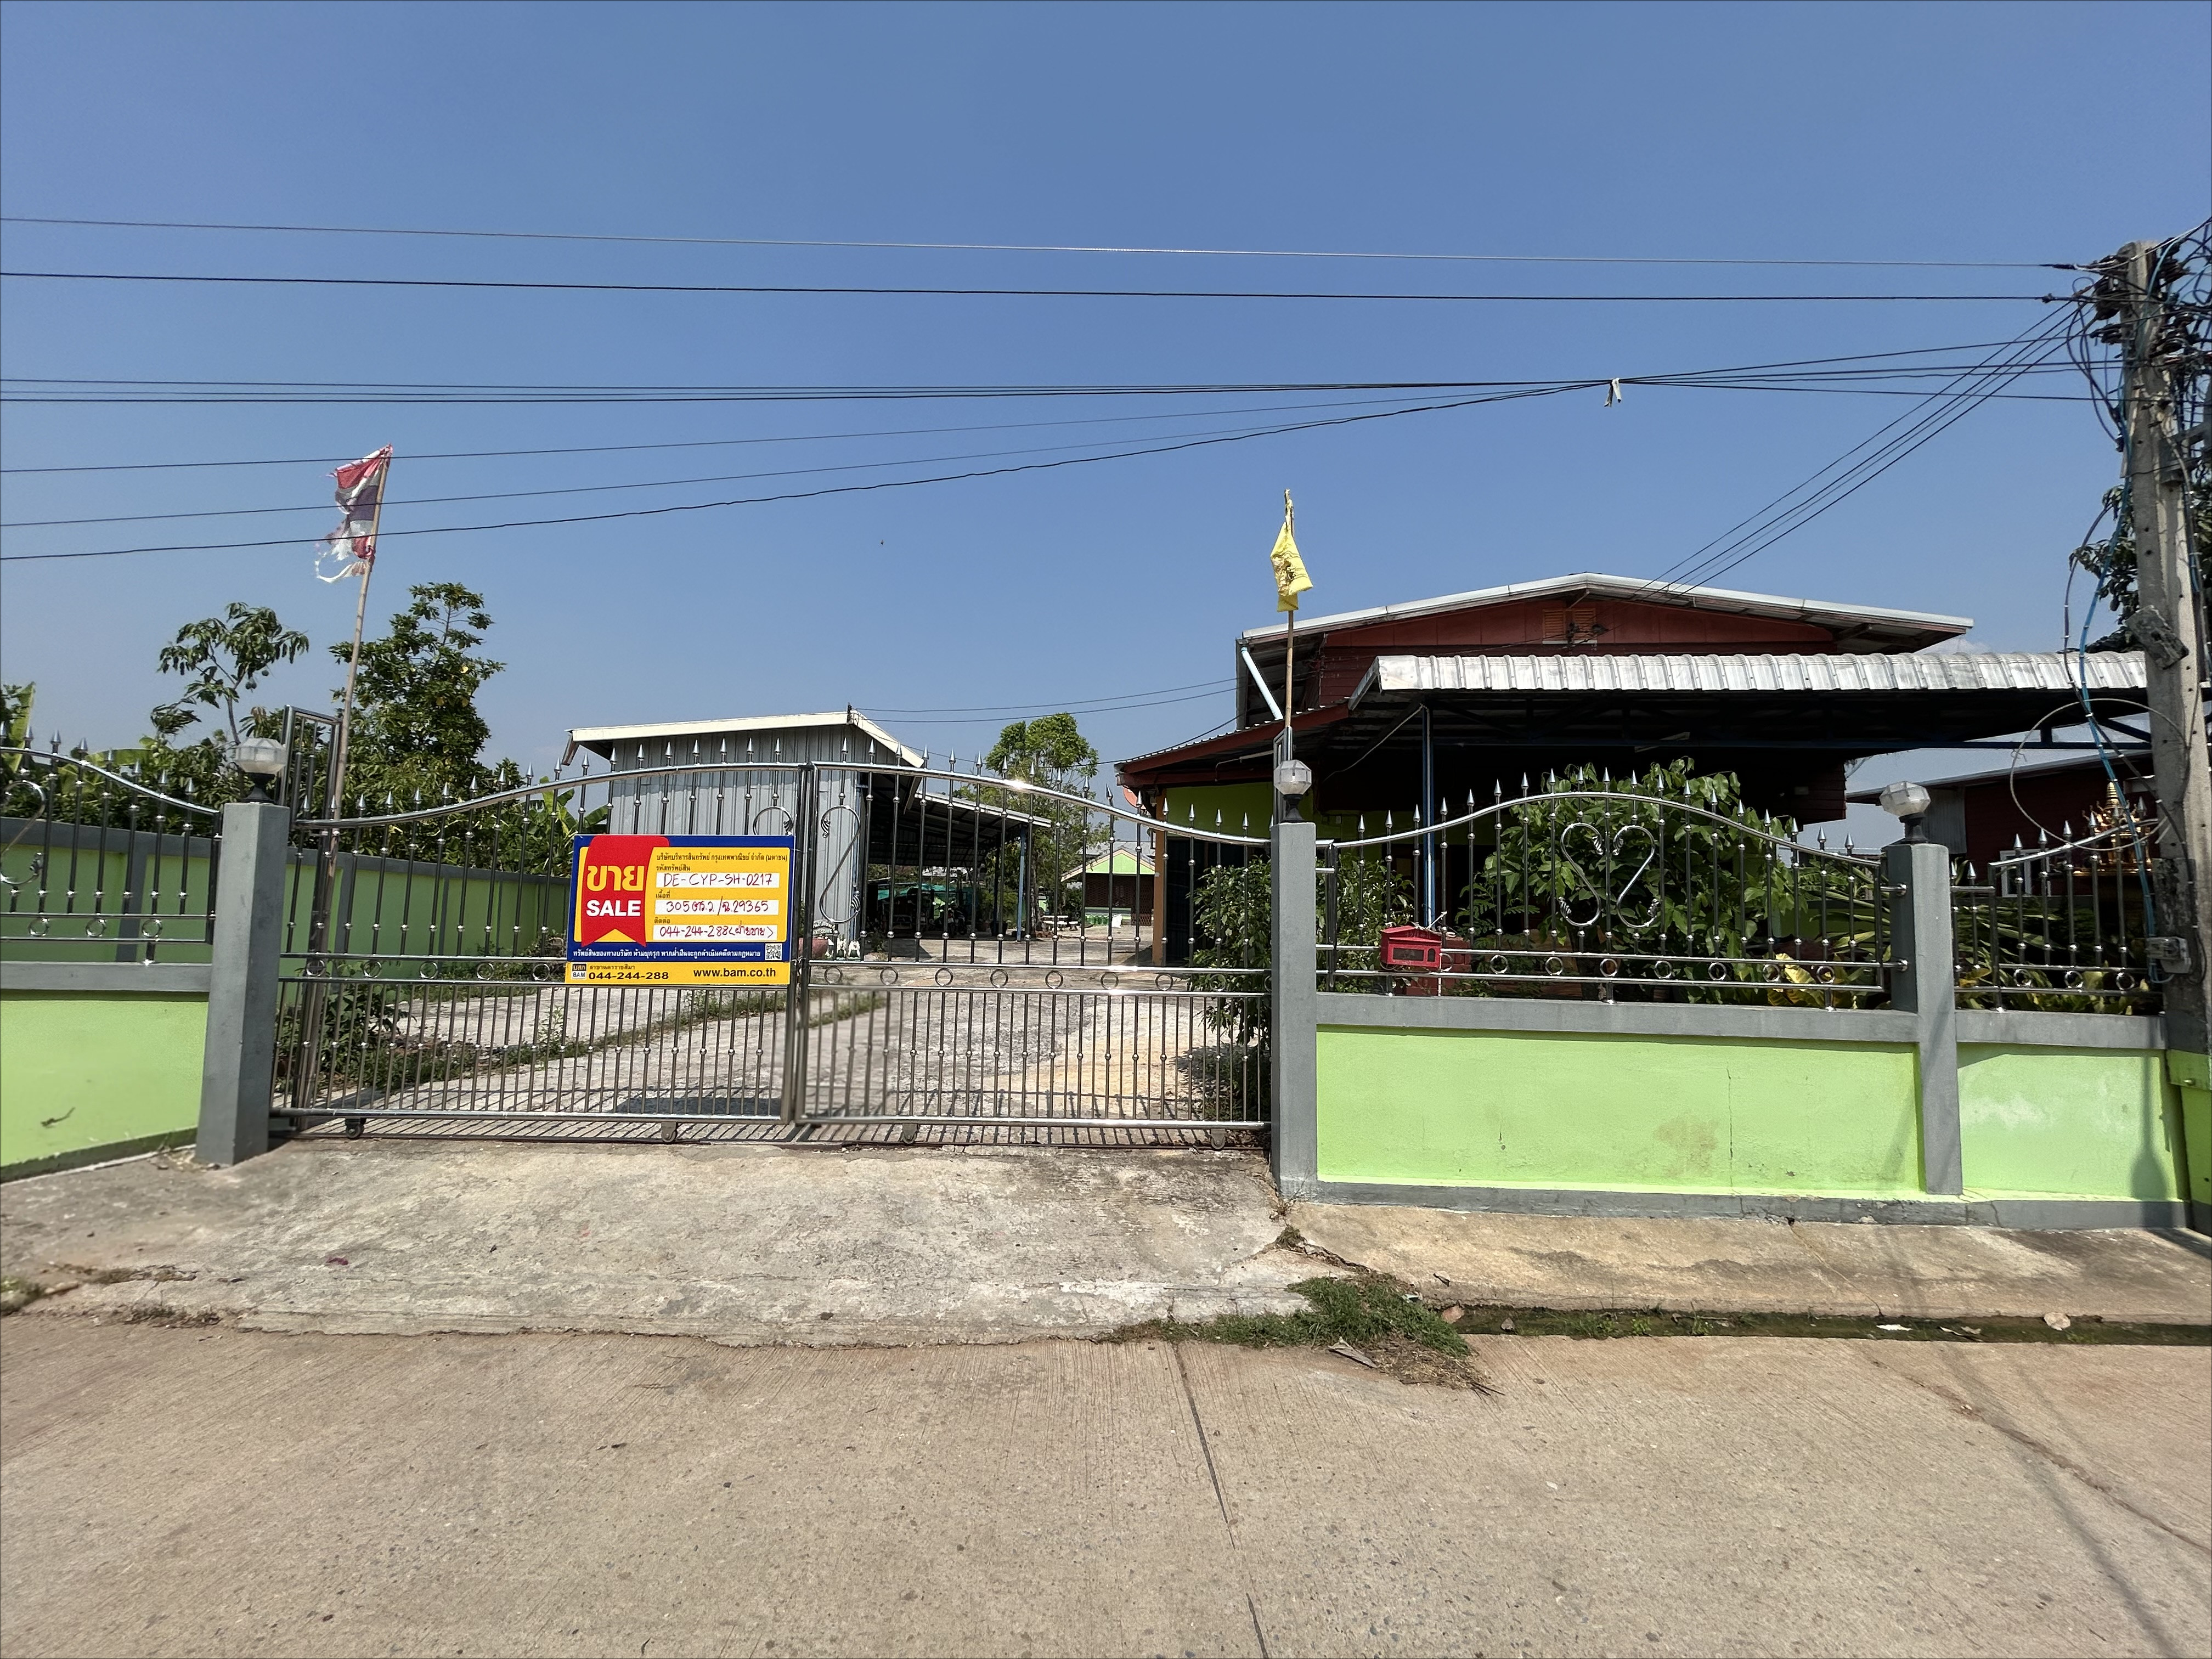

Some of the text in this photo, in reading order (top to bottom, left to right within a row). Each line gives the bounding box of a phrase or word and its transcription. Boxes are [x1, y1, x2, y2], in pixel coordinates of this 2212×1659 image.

[586, 865, 645, 891] ขาย
[586, 899, 641, 917] SALE
[589, 972, 669, 980] 044-244-288
[693, 968, 776, 977] www.bam.co.th
